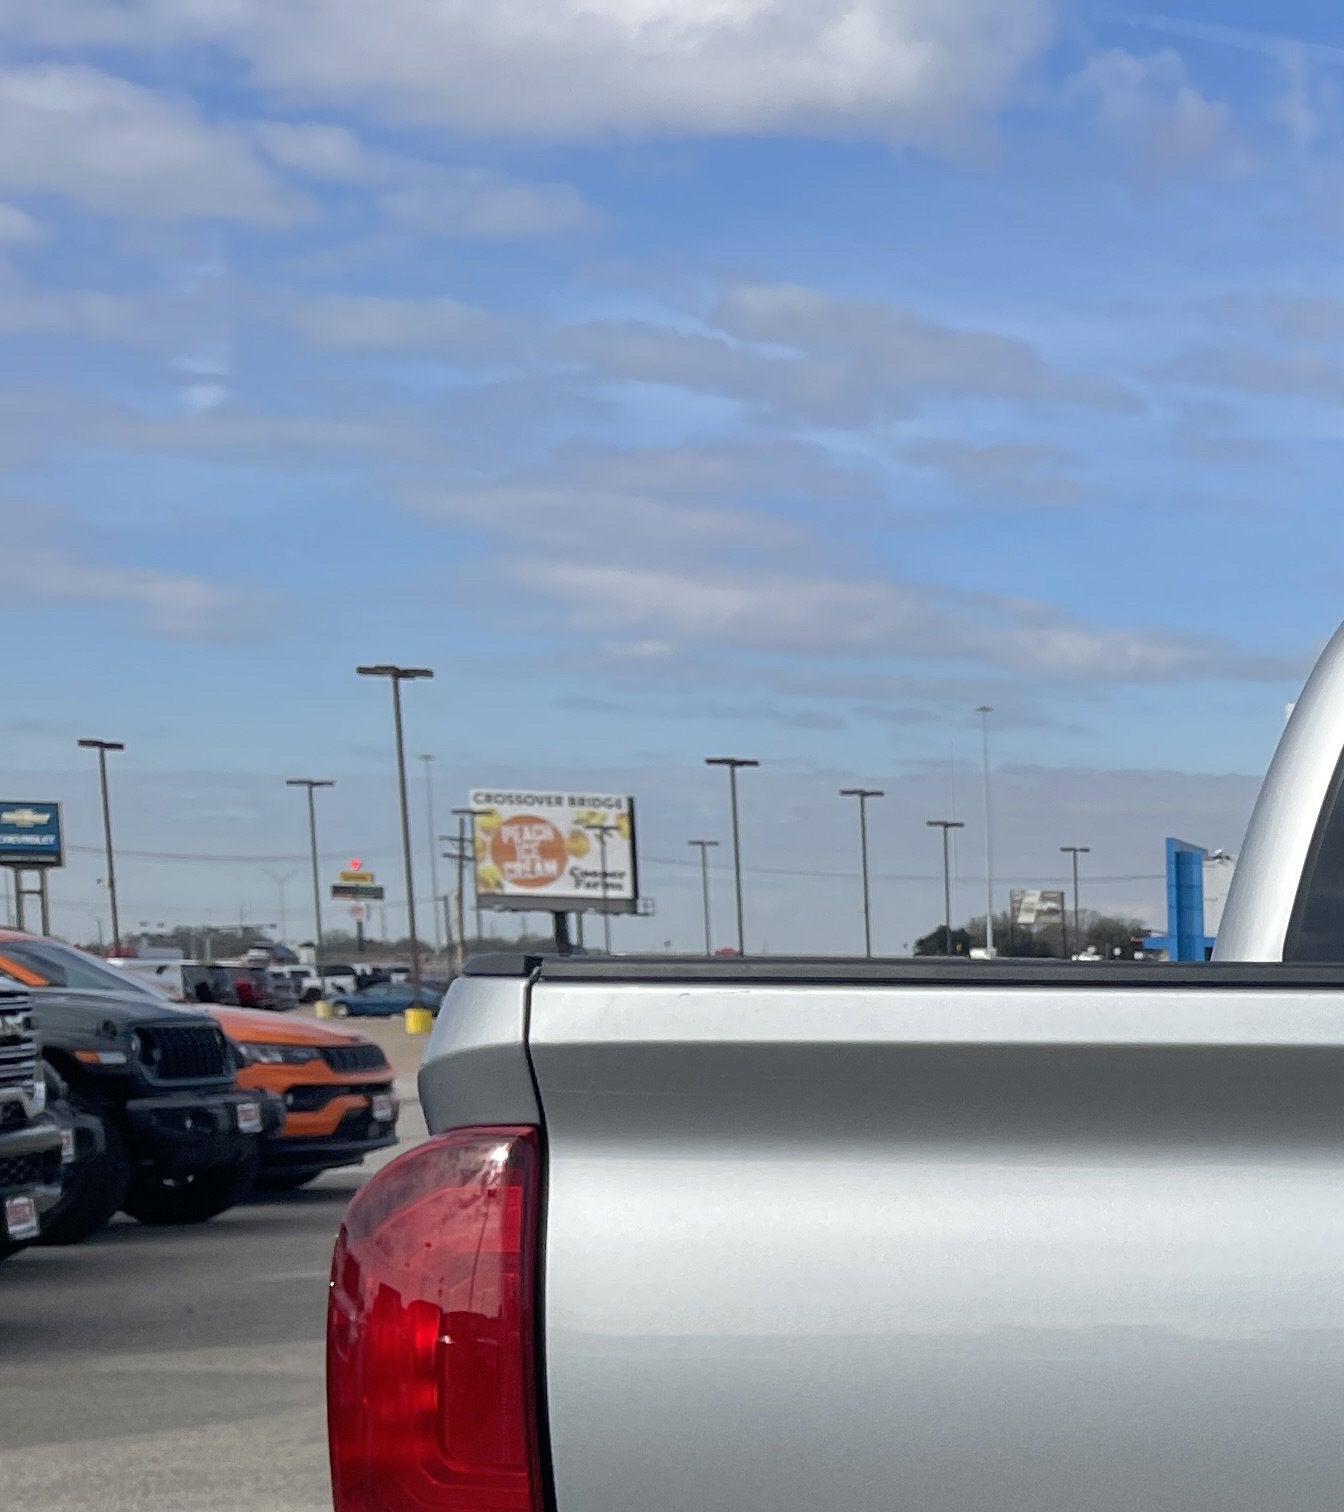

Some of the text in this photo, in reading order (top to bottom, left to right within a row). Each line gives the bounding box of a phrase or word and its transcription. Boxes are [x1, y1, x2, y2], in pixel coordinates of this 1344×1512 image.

[473, 792, 623, 810] CROSSOVER BRIDGE
[0, 834, 56, 845] HEVROLET
